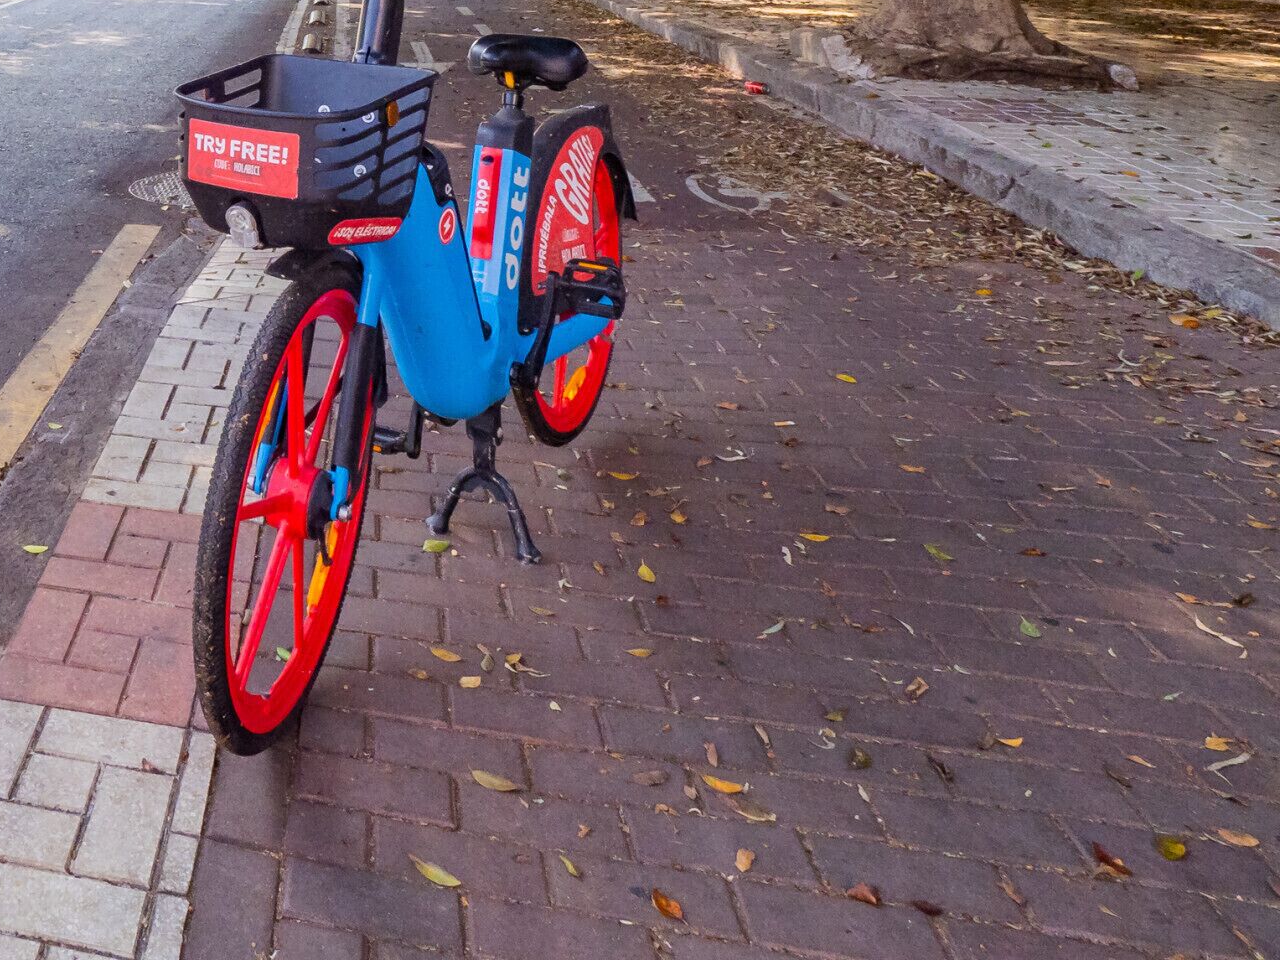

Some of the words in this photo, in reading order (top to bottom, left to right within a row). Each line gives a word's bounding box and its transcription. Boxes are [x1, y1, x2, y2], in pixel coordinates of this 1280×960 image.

[194, 133, 226, 155] TRY
[229, 139, 289, 165] FREE!
[554, 134, 595, 226] GRATIS!
[475, 178, 491, 214] dott
[505, 166, 530, 290] dott
